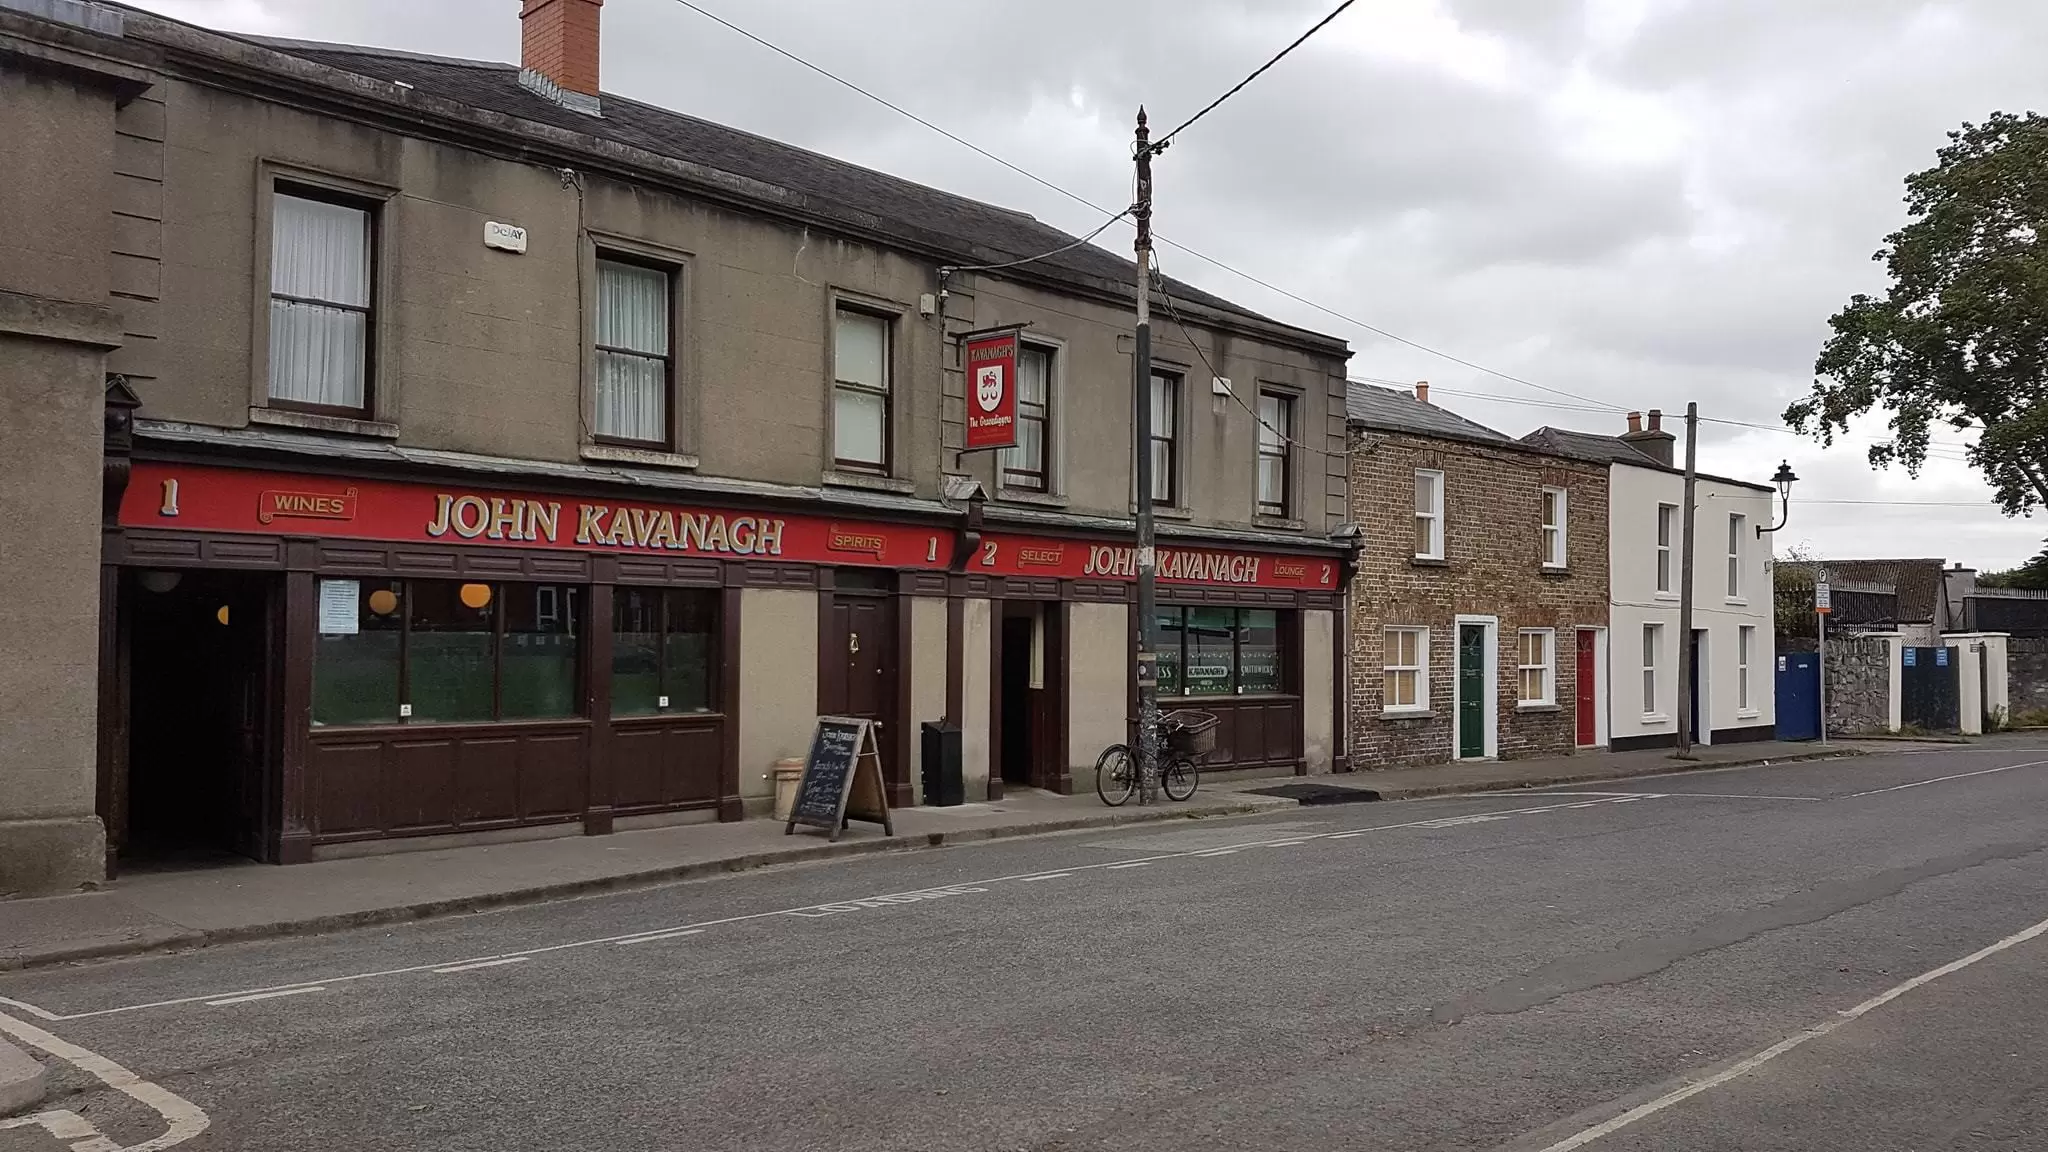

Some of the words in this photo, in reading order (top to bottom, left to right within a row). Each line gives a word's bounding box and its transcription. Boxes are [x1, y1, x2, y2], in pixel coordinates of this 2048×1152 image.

[971, 344, 1014, 362] KAVANAGH'S
[969, 416, 979, 428] The
[160, 478, 178, 516] 1
[274, 495, 345, 514] WINES
[427, 494, 561, 541] JOHN
[576, 504, 785, 555] KAVANAGH
[835, 535, 882, 549] SPIRITS
[926, 536, 938, 561] 1
[981, 541, 998, 566] 2
[1021, 550, 1060, 562] SELECT
[1154, 550, 1260, 582] KAVANAGH
[1274, 566, 1304, 576] LOUNGE
[1320, 564, 1331, 584] 2
[786, 886, 990, 918] LOADING
